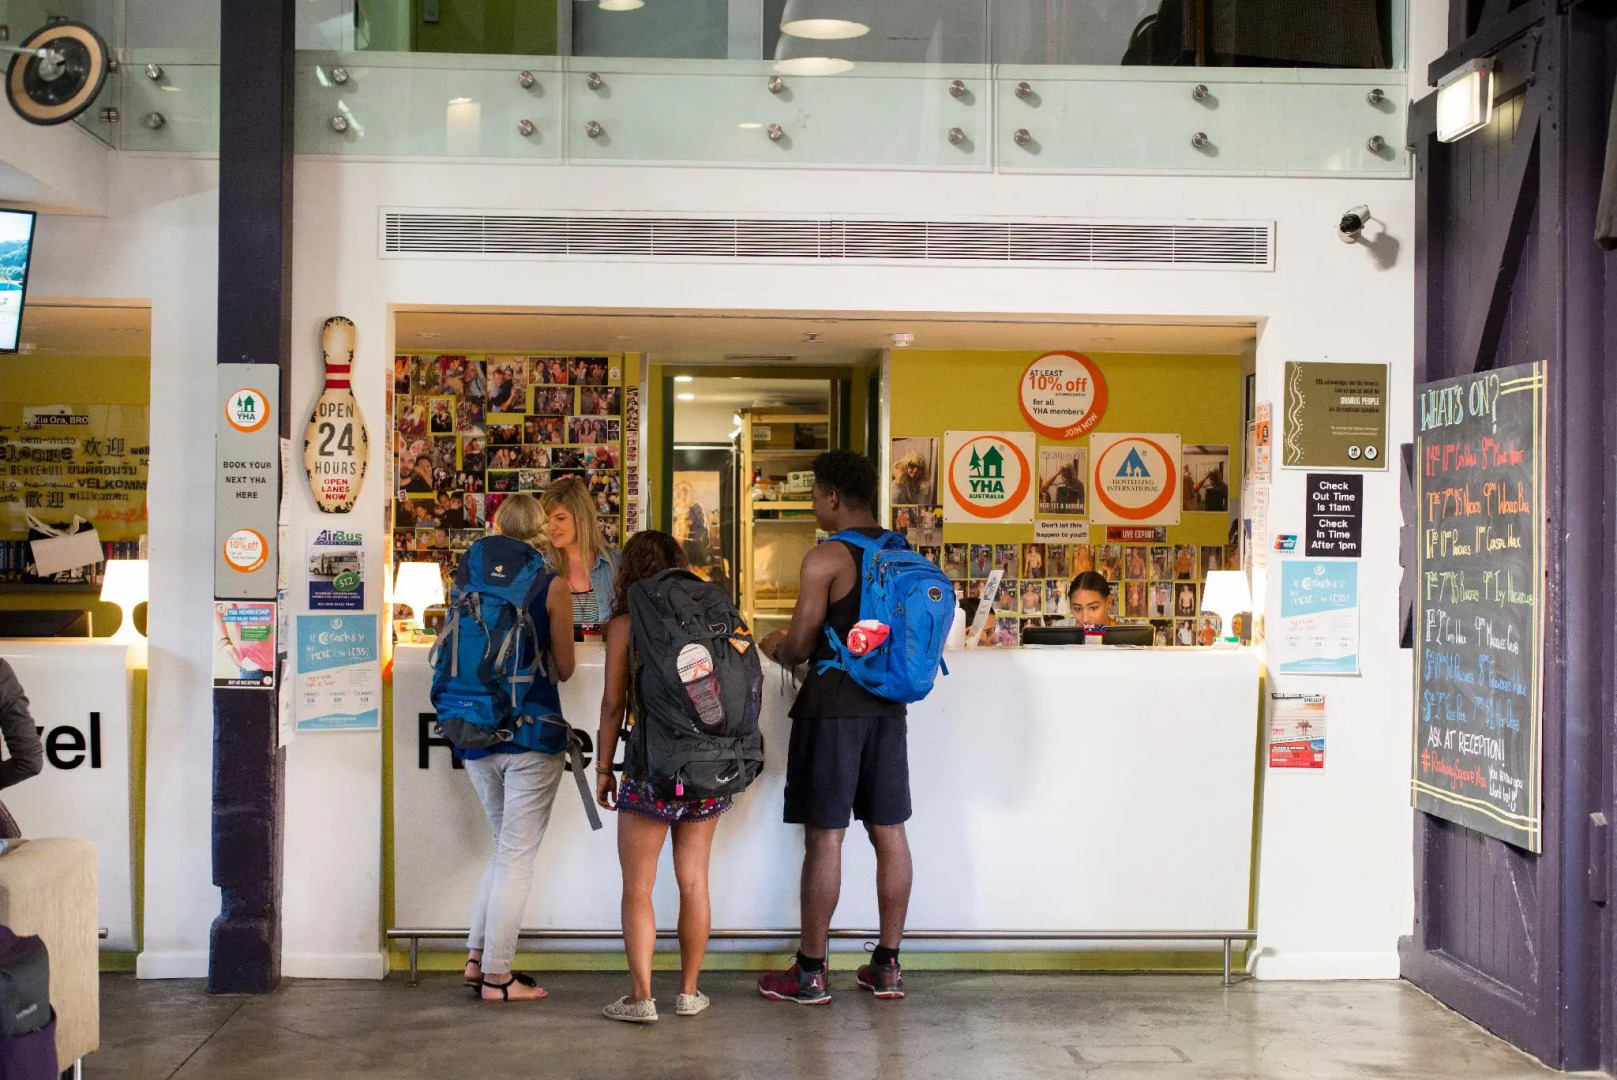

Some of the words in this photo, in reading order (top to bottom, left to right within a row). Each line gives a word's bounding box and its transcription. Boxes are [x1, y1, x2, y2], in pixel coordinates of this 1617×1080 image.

[1030, 376, 1062, 391] 10%
[1065, 377, 1087, 392] off
[1361, 397, 1380, 405] PEOPLE
[1420, 385, 1463, 431] WHAT'S
[1469, 373, 1500, 434] ON?
[319, 403, 354, 418] OPEN
[35, 416, 48, 424] Kia
[50, 416, 66, 425] Ora,
[1064, 427, 1082, 437] JOIN
[1082, 413, 1098, 430] NOW
[318, 422, 355, 456] 24
[223, 461, 246, 469] BOOK
[315, 461, 357, 474] HOURS
[969, 480, 1004, 493] YHA
[1319, 481, 1349, 490] Check
[1313, 492, 1329, 500] Out
[1333, 492, 1355, 501] Time
[1317, 503, 1326, 511] Is
[1329, 503, 1350, 511] 11am
[1319, 519, 1348, 528] Check
[1122, 530, 1134, 538] LIVE
[1134, 530, 1155, 538] EXPORT
[1316, 530, 1325, 538] In
[1328, 530, 1350, 539] Time
[1311, 541, 1335, 549] After
[1338, 541, 1357, 551] 1pm
[1426, 725, 1442, 748] ASK
[1444, 728, 1456, 750] AT
